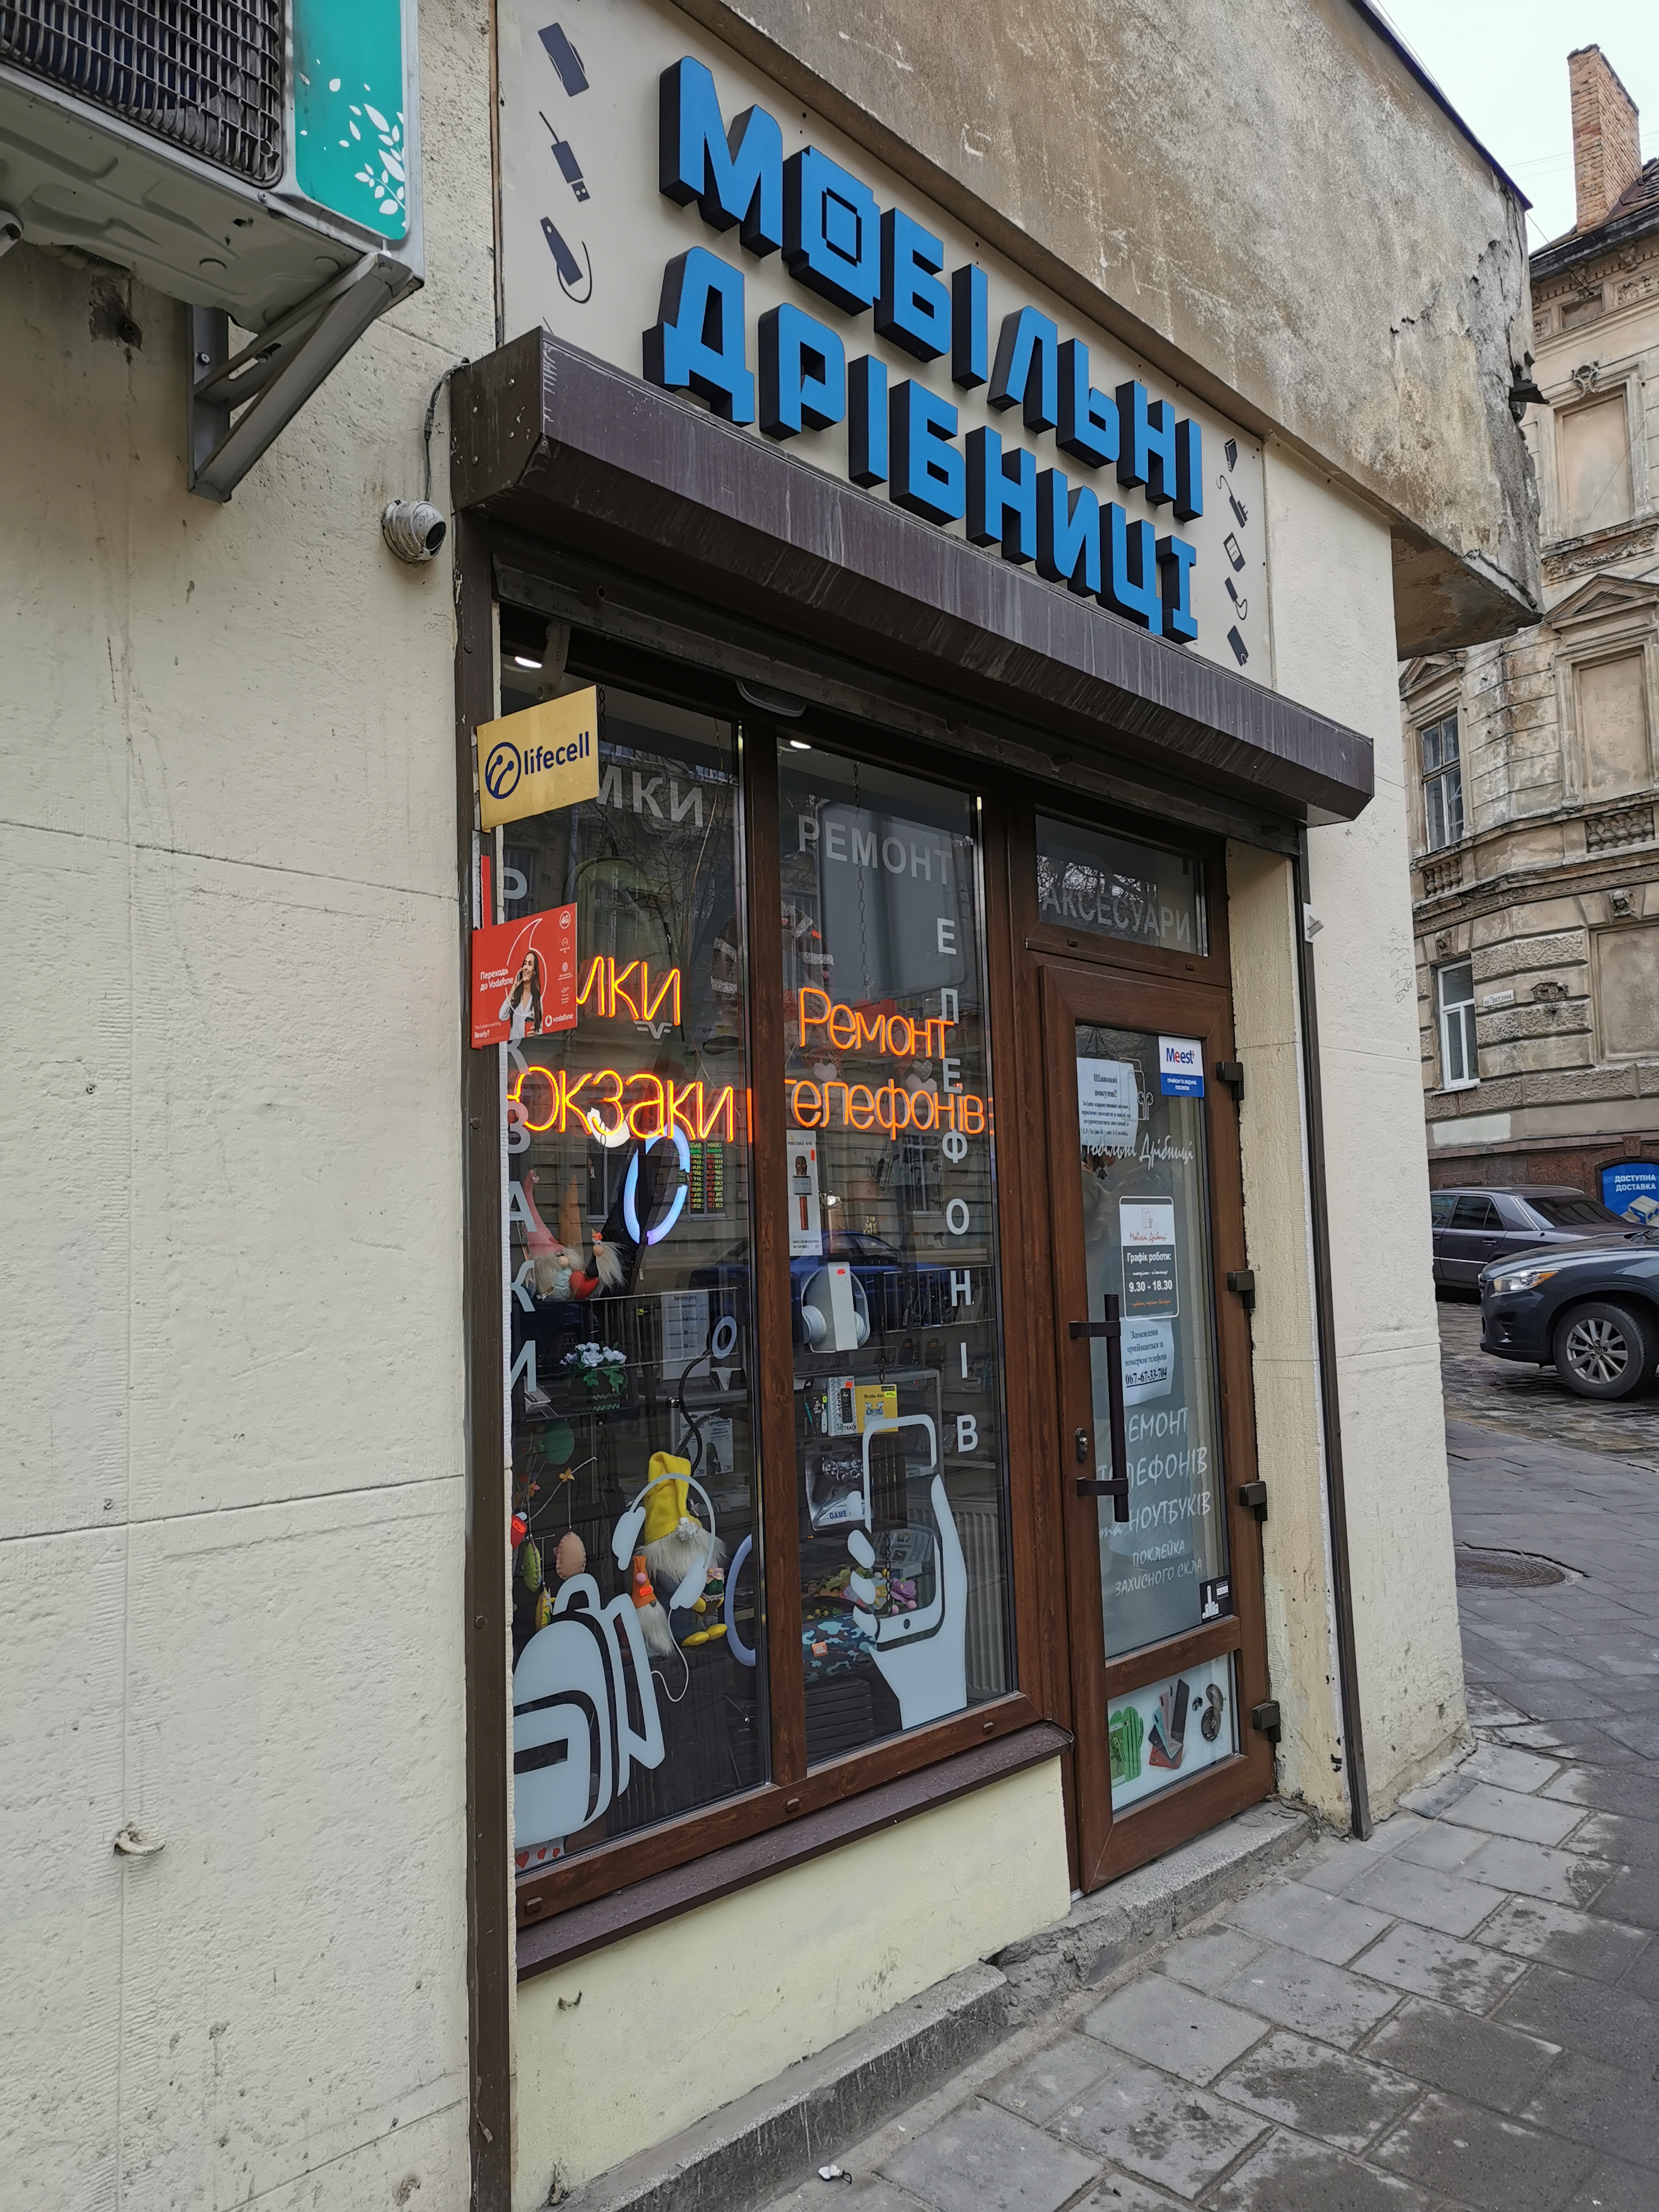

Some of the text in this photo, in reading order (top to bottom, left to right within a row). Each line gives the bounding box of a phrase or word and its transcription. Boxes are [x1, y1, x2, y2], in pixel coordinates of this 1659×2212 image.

[659, 55, 1204, 523] МОБІЛЬНІ
[642, 246, 1198, 645] ДРІБНИЦІ
[525, 731, 589, 775] lifecell
[798, 813, 953, 885] РЕМОНТ
[1041, 884, 1191, 943] АКСЕСУАРИ
[480, 969, 509, 980] Переходь
[480, 977, 514, 992] до Vodafone
[553, 1013, 574, 1023] vodafone
[799, 987, 954, 1059] Ремонт
[474, 1030, 490, 1039] Ready?
[1166, 1048, 1193, 1064] Meest
[1094, 1074, 1118, 1084] Шановні
[1094, 1090, 1117, 1099] покупці!
[506, 1065, 734, 1143] юкзаки
[785, 1078, 985, 1141] елефонів
[1139, 1132, 1194, 1171] Дрібниці
[1614, 1174, 1657, 1183] ДОСТУПНА
[1615, 1183, 1657, 1192] ДОСТАВКА
[1127, 1251, 1172, 1264] Графік роботи:
[1129, 1281, 1145, 1293] 9.30
[1152, 1279, 1173, 1291] 18.30
[1130, 1329, 1158, 1339] Замовлення
[1127, 1342, 1159, 1355] приймаються
[1125, 1358, 1148, 1367] номером
[1125, 1367, 1167, 1385] 067-67-33-704
[1125, 1407, 1188, 1443] ЕМОНТ
[1097, 1446, 1208, 1489] ТЛЕФОНІВ
[830, 1510, 848, 1520] GAME
[1128, 1491, 1211, 1533] НОУТБУКІВ
[1133, 1538, 1185, 1567] ПОКЛЕЙКА
[1114, 1558, 1203, 1597] ЗАХИСНОГО СКЛА
